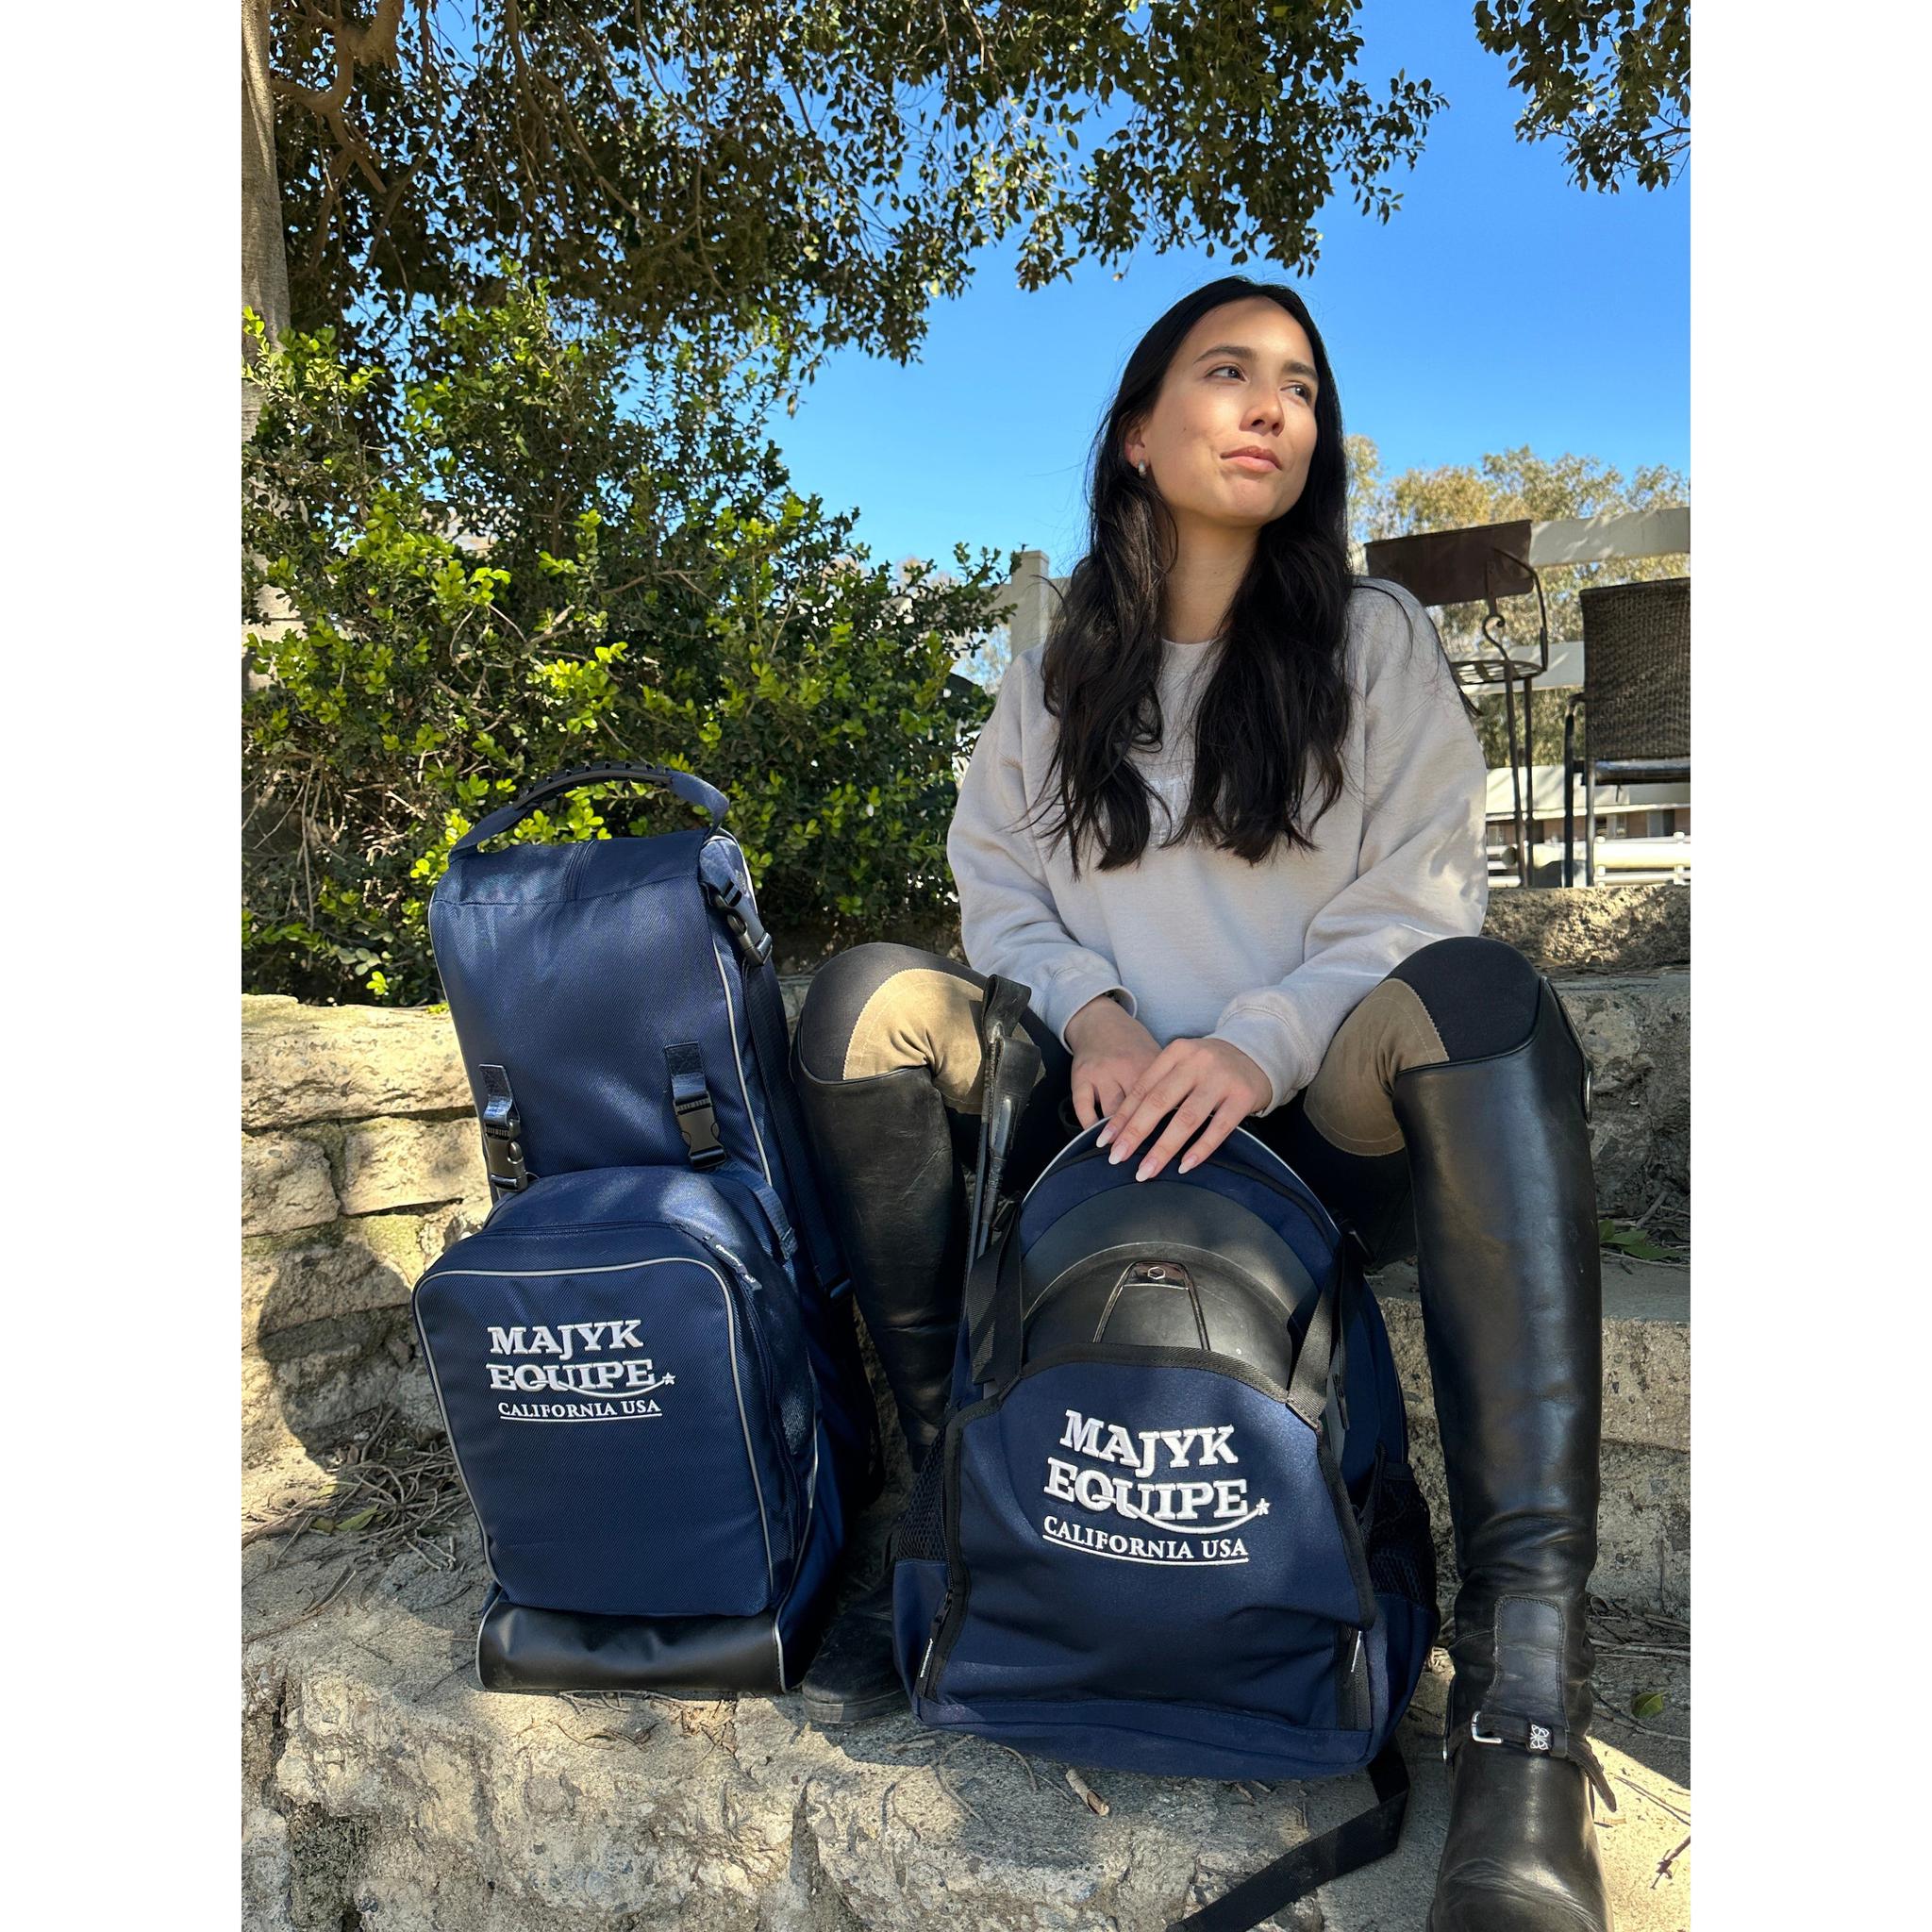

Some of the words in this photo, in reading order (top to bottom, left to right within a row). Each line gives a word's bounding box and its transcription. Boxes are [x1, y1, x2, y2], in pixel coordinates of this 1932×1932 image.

[486, 1320, 644, 1359] MAJYK
[486, 1359, 655, 1392] EQUIPE
[497, 1402, 617, 1418] CALIFORNIA
[621, 1399, 661, 1413] USA
[1059, 1409, 1239, 1477] MAJYK
[1043, 1457, 1248, 1521] EQUIPE
[1043, 1515, 1194, 1559] CALIFORNIA
[1201, 1538, 1248, 1557] USA
